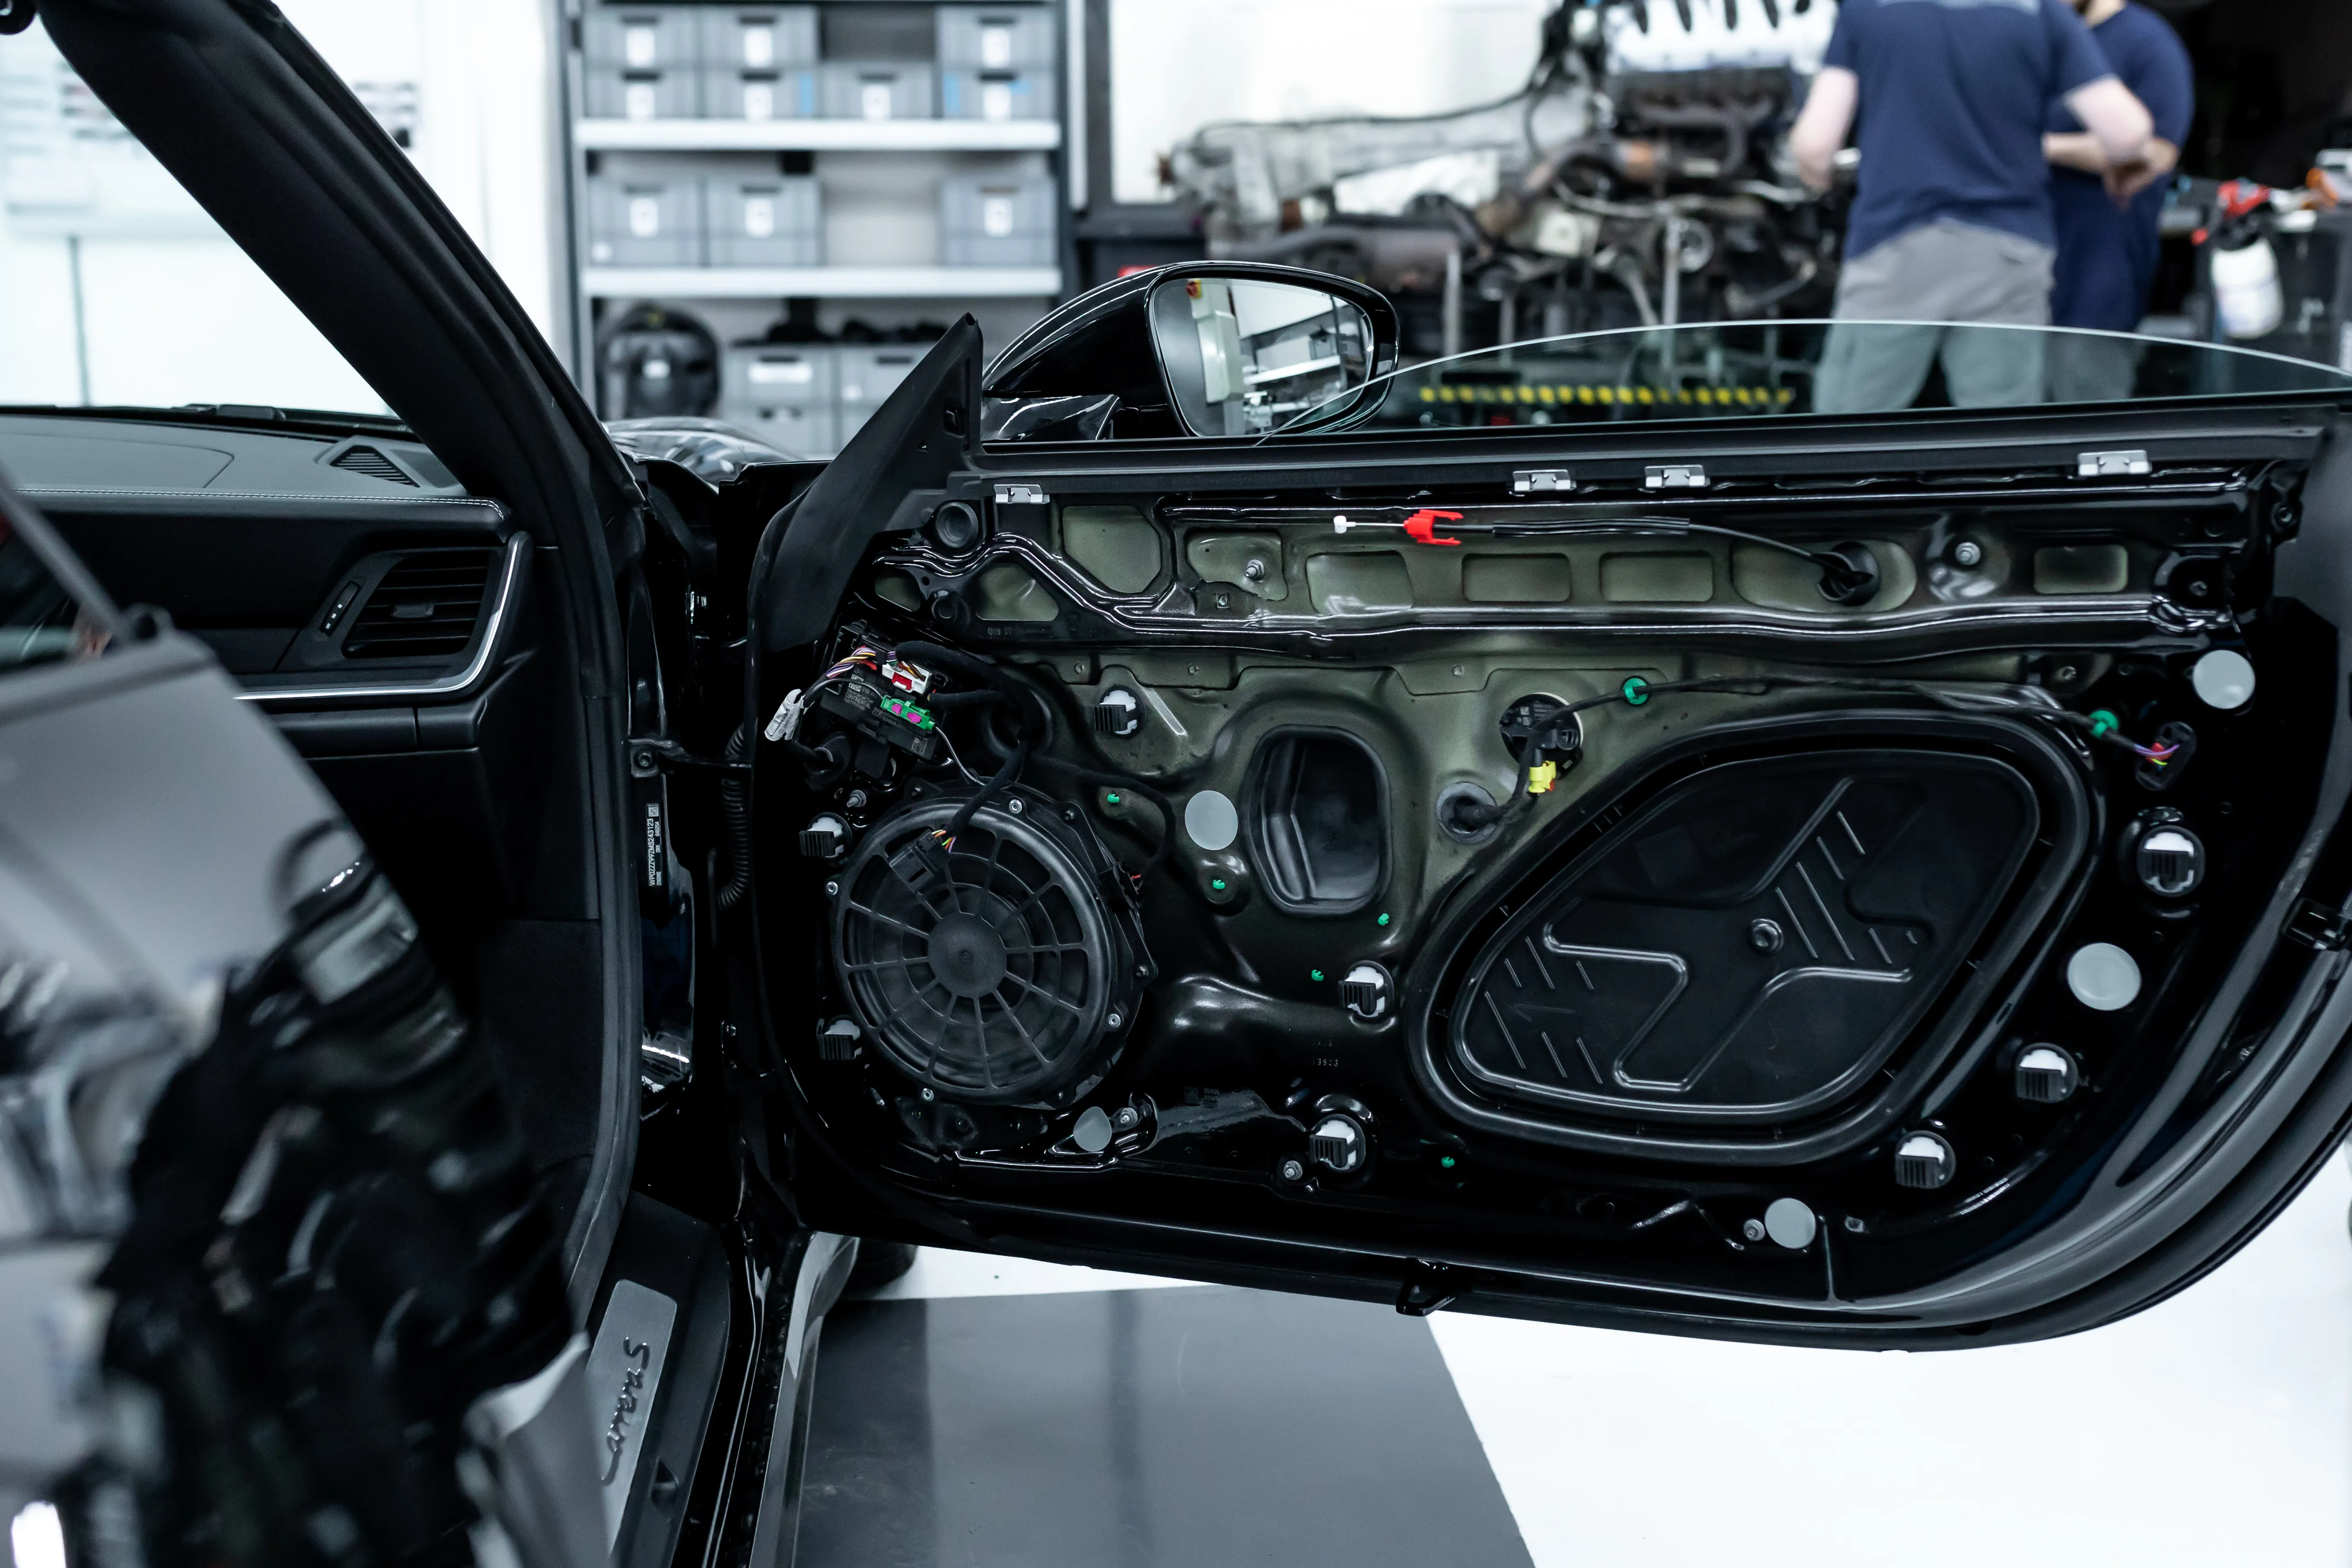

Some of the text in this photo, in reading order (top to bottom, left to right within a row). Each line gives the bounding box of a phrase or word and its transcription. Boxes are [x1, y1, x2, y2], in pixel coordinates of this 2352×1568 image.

[845, 692, 871, 709] CONTINENTAL
[647, 818, 656, 886] WP0ZZZ99ZMS243123
[601, 1336, 650, 1486] Carrera S
